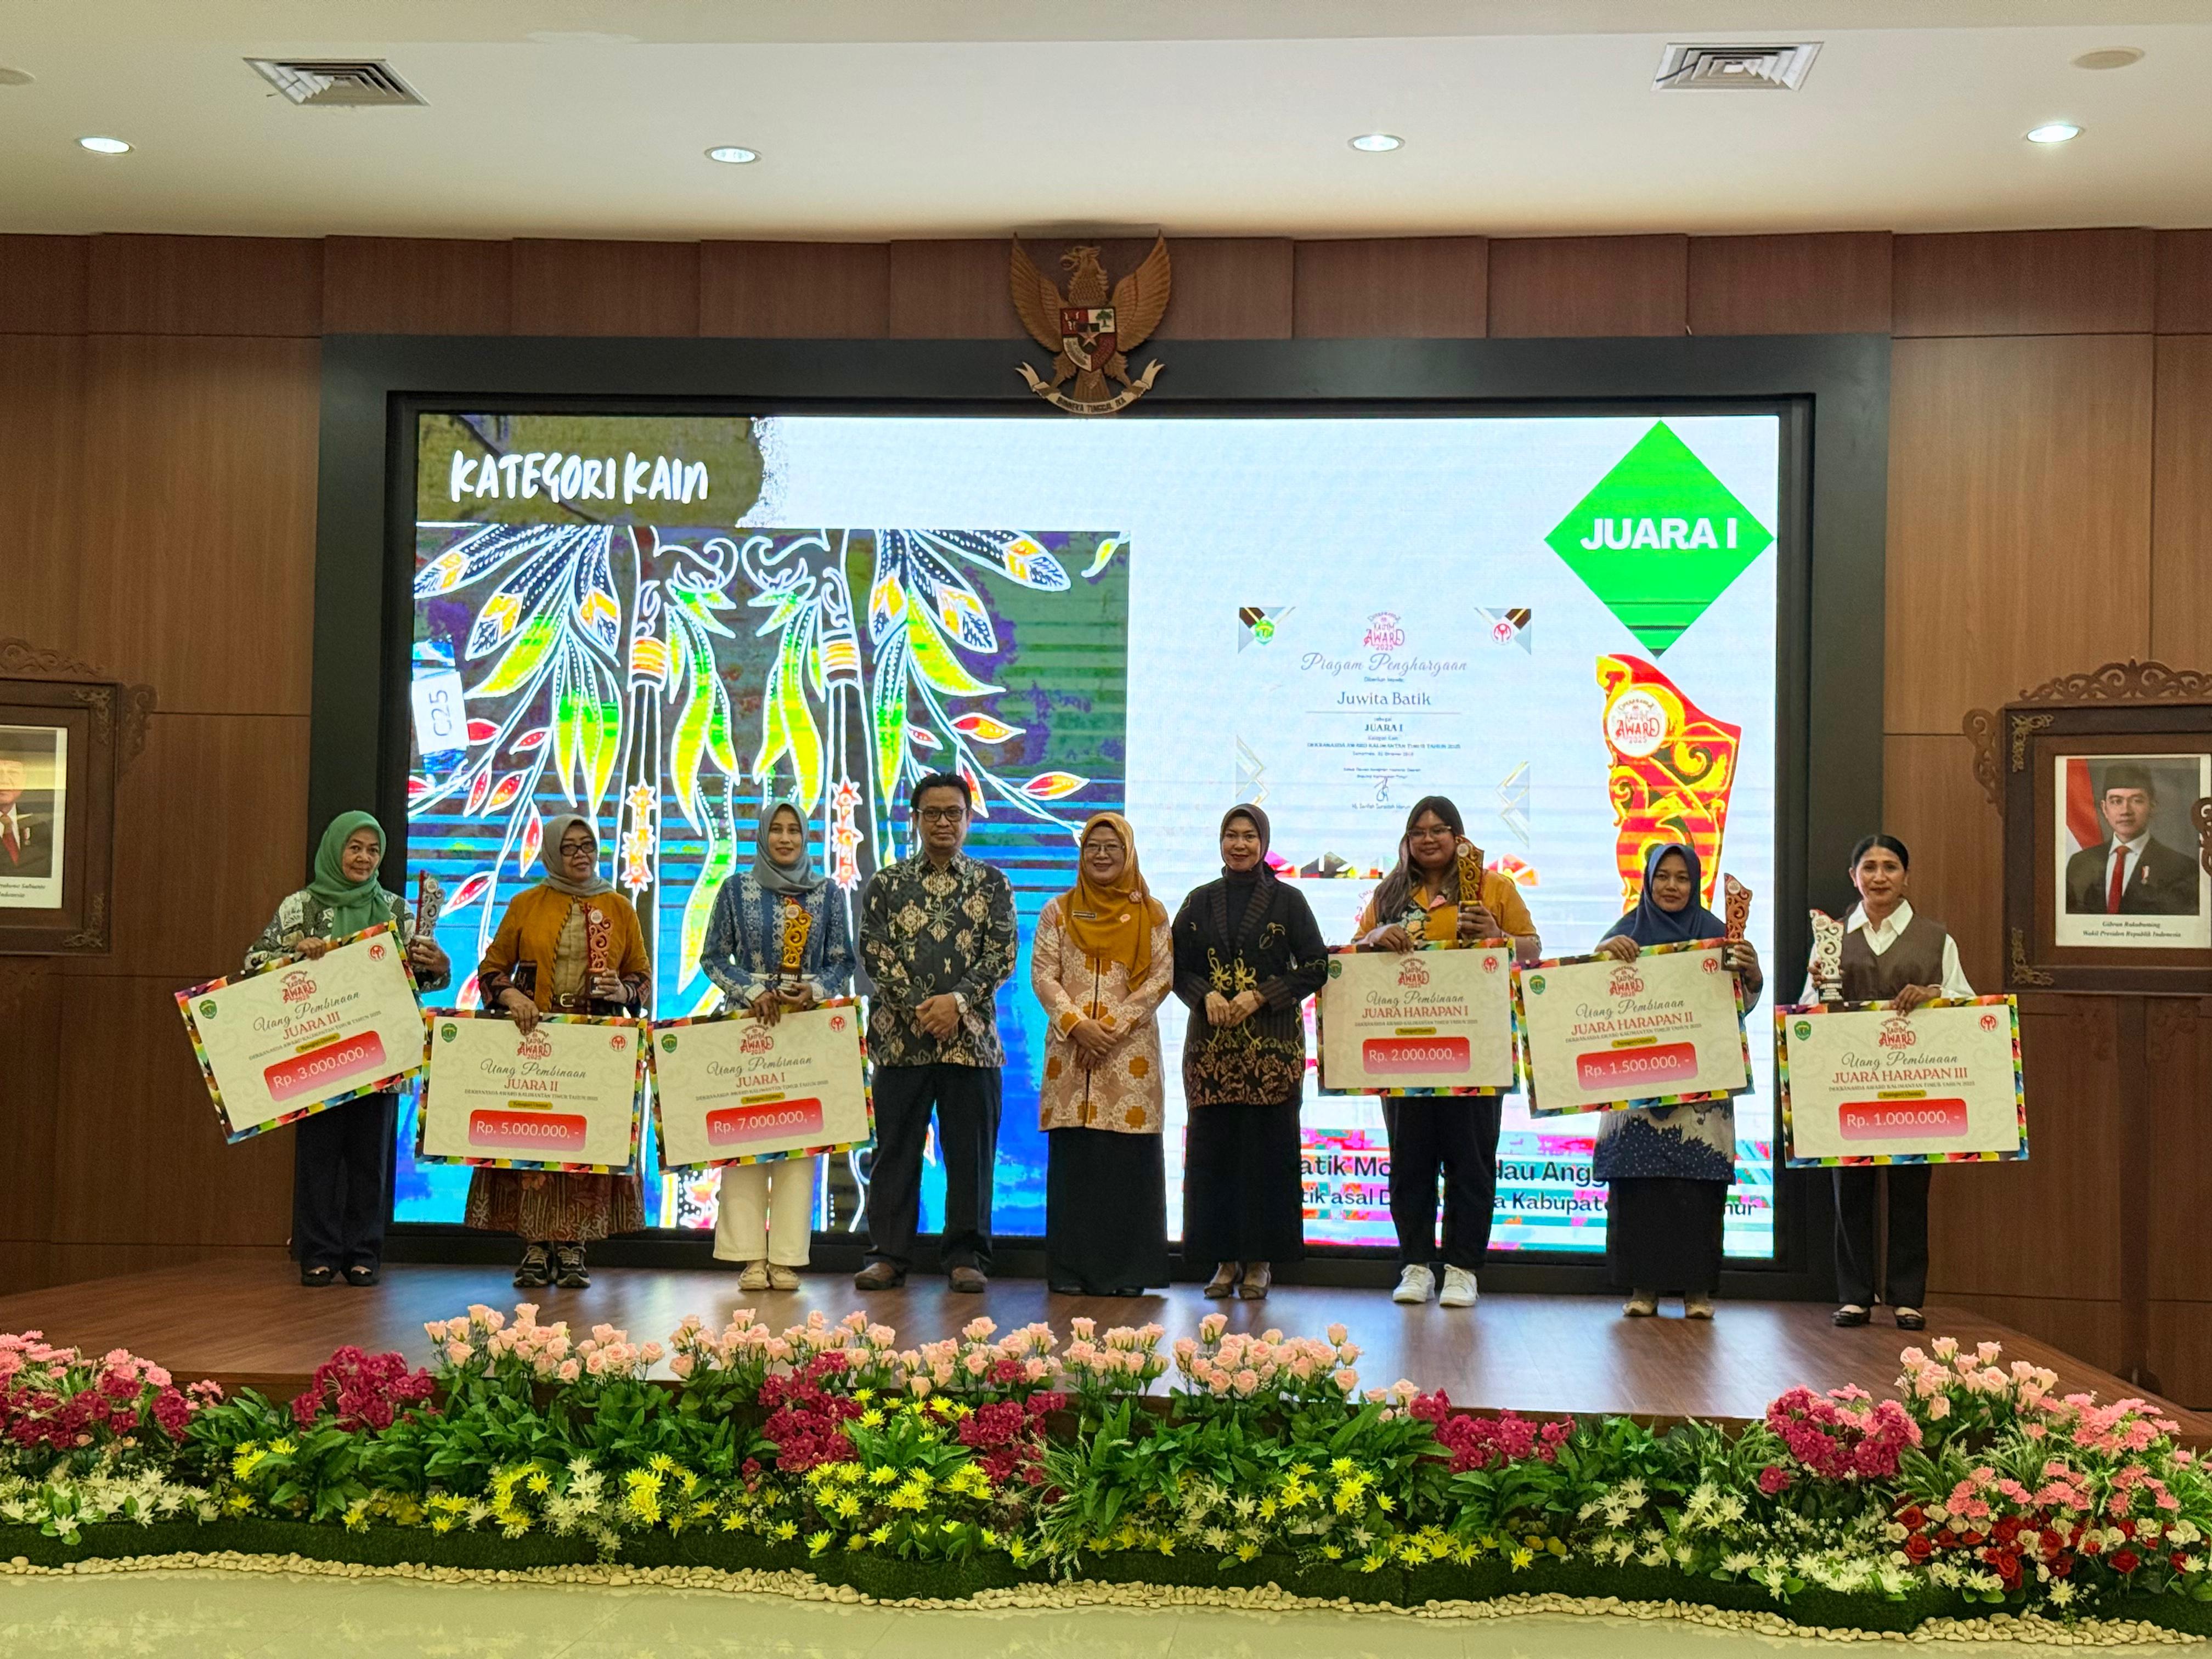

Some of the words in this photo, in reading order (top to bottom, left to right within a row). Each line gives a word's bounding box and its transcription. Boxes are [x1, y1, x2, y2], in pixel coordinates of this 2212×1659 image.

[450, 450, 616, 503] KATEGORI
[624, 452, 709, 504] KAIN
[1579, 517, 1719, 550] JUARA
[1726, 517, 1737, 549] I
[1363, 629, 1405, 647] AWARD
[1301, 652, 1362, 676] Piagam
[1368, 653, 1467, 677] Penghargaan
[1337, 692, 1388, 705] Juwita
[1392, 692, 1431, 706] Batik
[430, 690, 452, 737] C25
[1615, 718, 1660, 740] AWARD
[1398, 970, 1430, 986] AWARD
[1610, 978, 1644, 996] AWARD
[282, 980, 317, 1003] AWARD
[1366, 990, 1400, 1006] Uang
[1403, 990, 1464, 1005] Pembinaan
[253, 1016, 292, 1031] Uang
[295, 992, 360, 1019] Pembinaan
[1362, 1008, 1401, 1018] JUARA
[1404, 1006, 1462, 1018] HARAPAN
[1464, 1005, 1468, 1015] I
[1576, 1003, 1612, 1020] Uang
[1617, 999, 1685, 1014] Pembinaan
[283, 1017, 326, 1040] JUARA
[326, 1011, 341, 1024] III
[1571, 1020, 1615, 1036] JUARA
[1617, 1013, 1682, 1030] HARAPAN
[1685, 1011, 1693, 1022] II
[740, 1036, 774, 1053] AWARD
[1878, 1030, 1916, 1047] AWARD
[517, 1041, 552, 1057] AWARD
[1369, 1049, 1387, 1063] Rp.
[273, 1075, 296, 1088] Rp.
[298, 1047, 369, 1079] 3.000.000,
[480, 1058, 516, 1078] Uang
[521, 1062, 586, 1079] Pembinaan
[707, 1061, 742, 1076] Uang
[748, 1056, 812, 1071] Pembinaan
[1584, 1064, 1606, 1078] Rp.
[1610, 1055, 1681, 1075] 1.500.000,
[1842, 1052, 1881, 1070] Uang
[1887, 1052, 1957, 1066] Pembinaan
[736, 1074, 779, 1088] JUARA
[781, 1072, 786, 1082] I
[1832, 1071, 1880, 1084] JUARA
[1882, 1068, 1951, 1082] HARAPAN
[1955, 1067, 1967, 1079] III
[504, 1078, 547, 1091] JUARA
[550, 1081, 558, 1092] II
[714, 1121, 735, 1134] Rp.
[738, 1110, 808, 1130] 7.000.000,
[1847, 1114, 1869, 1128] Rp.
[1874, 1110, 1950, 1125] 1.000.000,
[476, 1121, 496, 1136] Rp.
[500, 1122, 570, 1138] 5.000.000,
[1301, 1155, 1346, 1176] atik
[1331, 1188, 1373, 1205] asal
